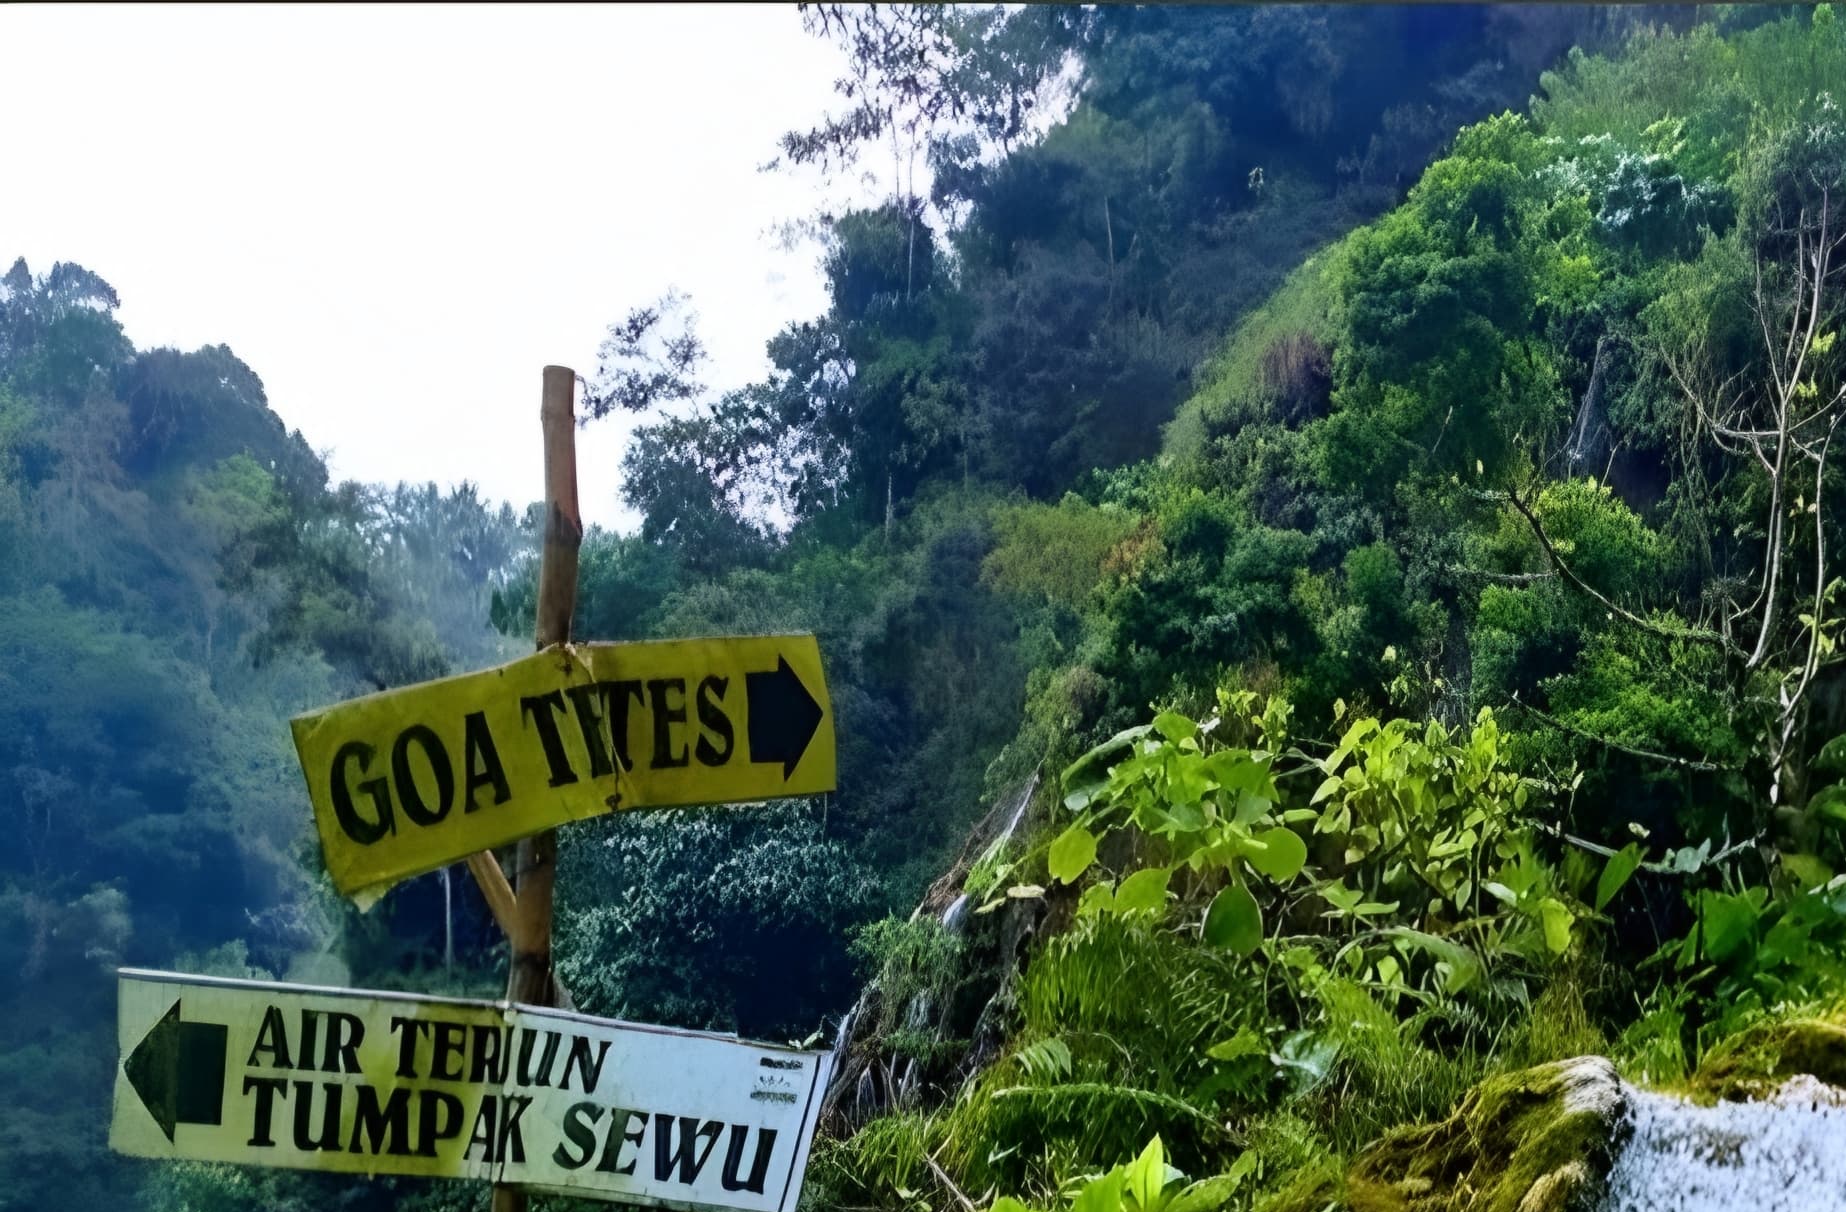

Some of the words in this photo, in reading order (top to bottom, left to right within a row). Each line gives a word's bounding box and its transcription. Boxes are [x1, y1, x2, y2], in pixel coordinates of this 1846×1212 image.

[329, 710, 513, 846] GOA
[246, 1004, 366, 1075] AIR
[242, 1075, 534, 1164] TUMPAK
[551, 1100, 779, 1196] SEWU
